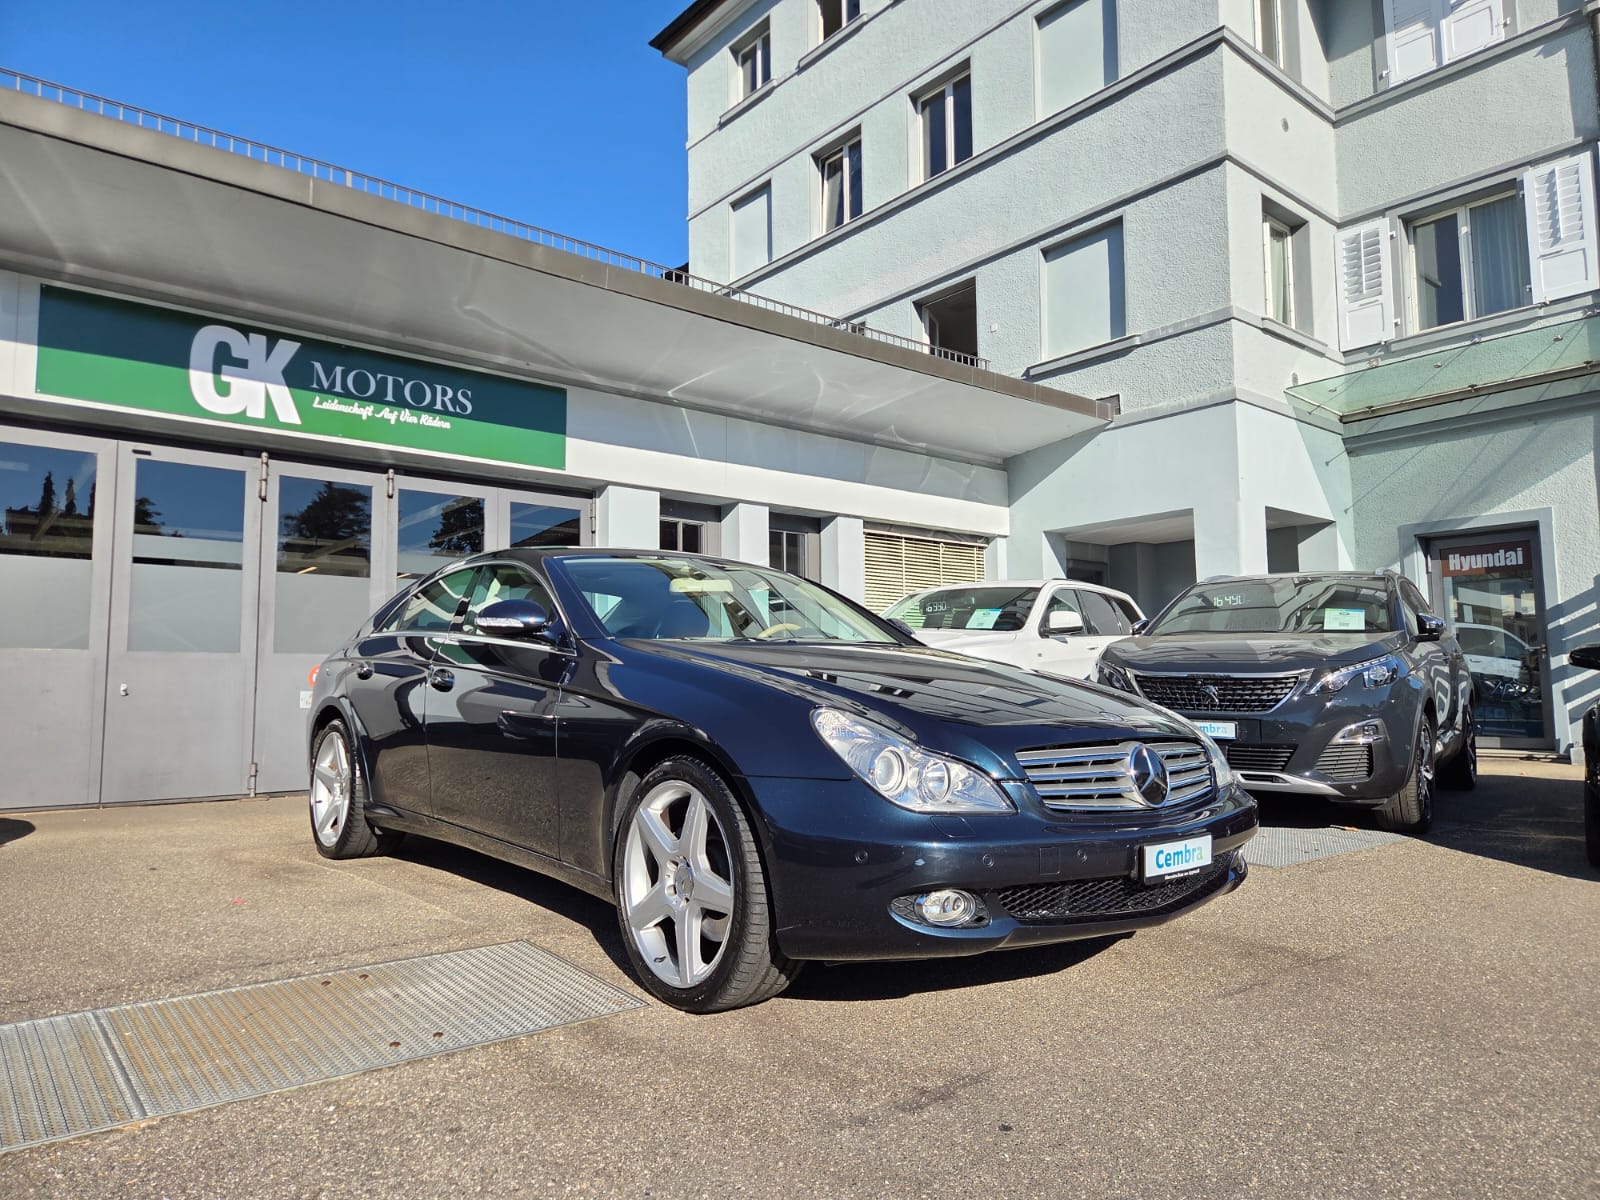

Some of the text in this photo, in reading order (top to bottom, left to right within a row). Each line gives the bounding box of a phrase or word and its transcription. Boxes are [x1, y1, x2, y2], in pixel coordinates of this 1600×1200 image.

[188, 324, 473, 425] GK MOTORS
[312, 396, 374, 420] Leidenschaft
[374, 407, 398, 425] Auf
[1448, 547, 1524, 571] Hyundai
[1199, 723, 1228, 734] mbra
[1155, 843, 1204, 869] Cembra
